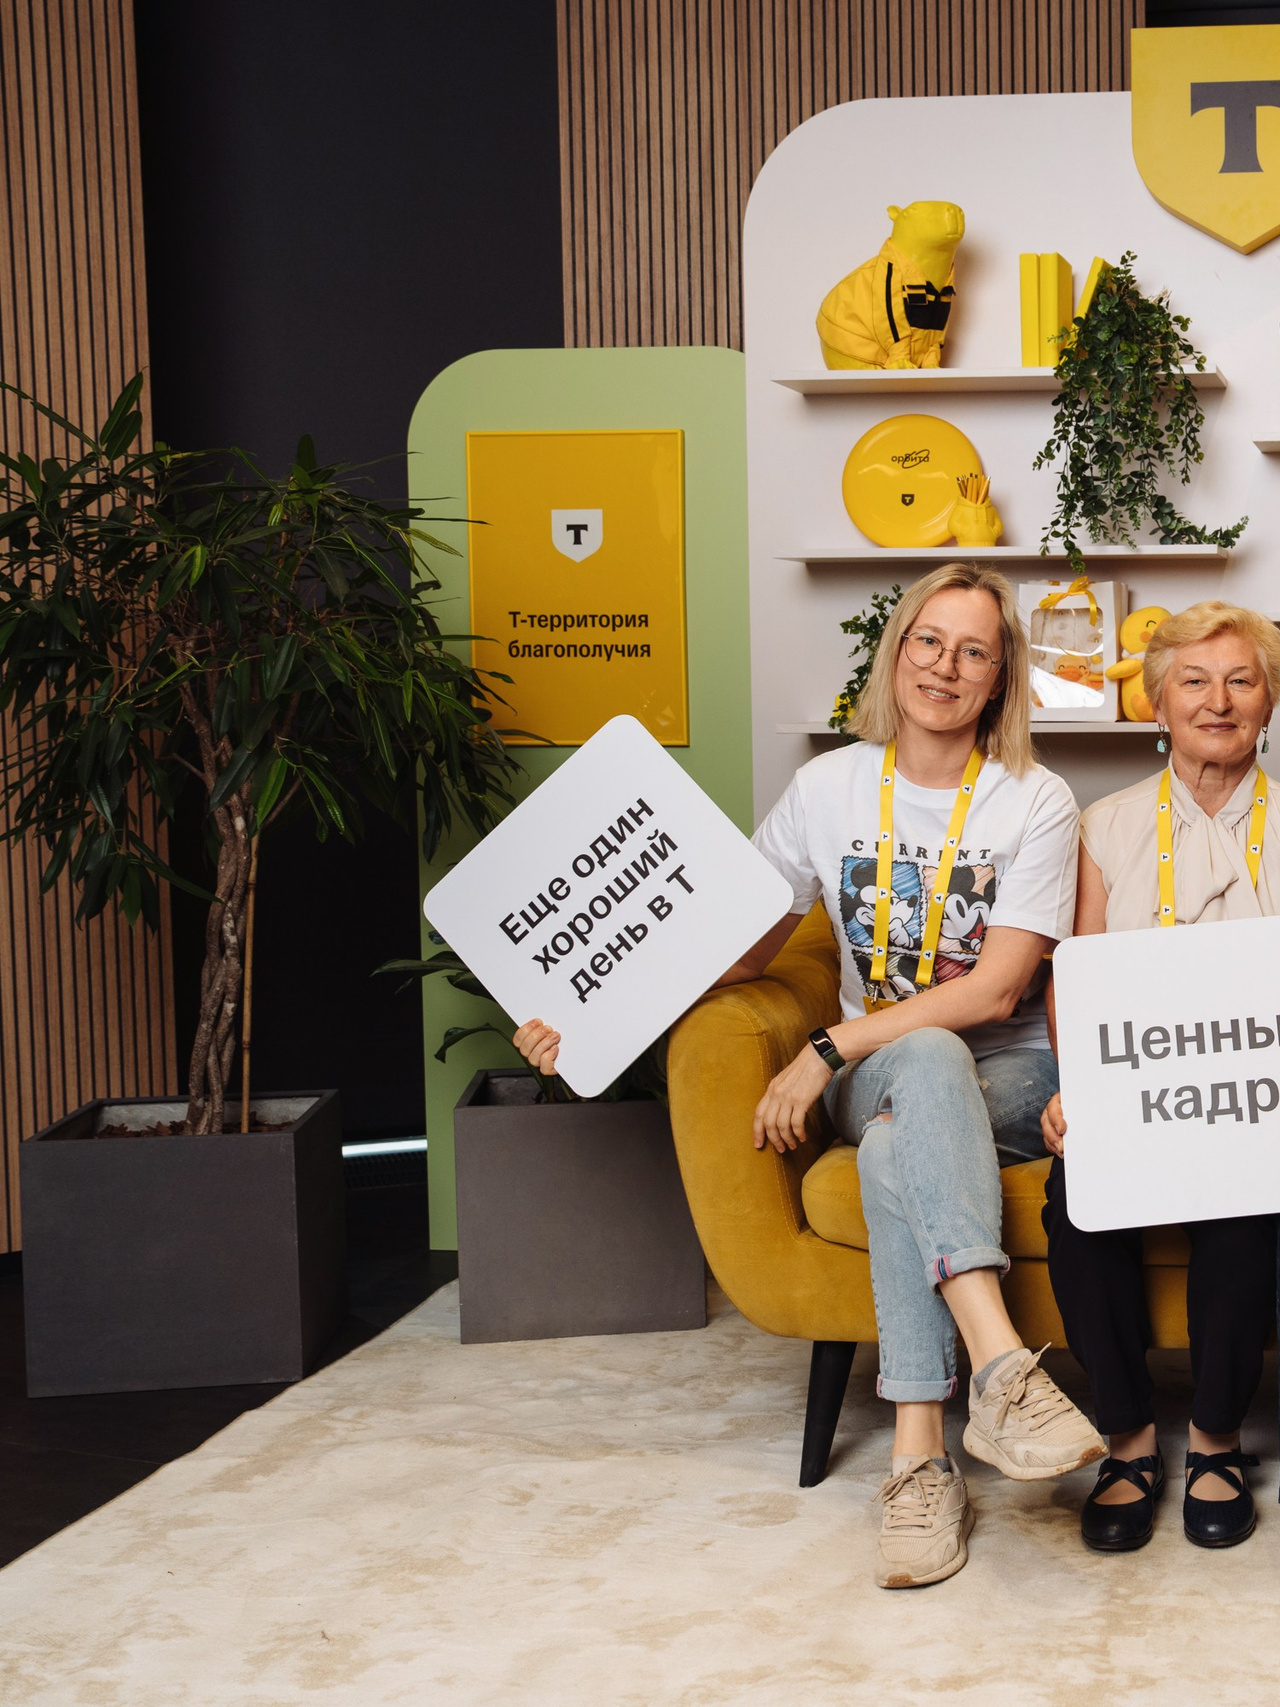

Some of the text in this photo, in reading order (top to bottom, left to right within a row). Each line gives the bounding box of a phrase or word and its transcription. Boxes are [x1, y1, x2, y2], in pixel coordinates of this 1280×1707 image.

[508, 611, 649, 632] Т-территория
[508, 639, 651, 662] благополучия
[499, 797, 655, 945] Еще один
[532, 829, 679, 975] хороший
[569, 864, 695, 1004] день в Т
[1141, 1076, 1280, 1125] кадр
